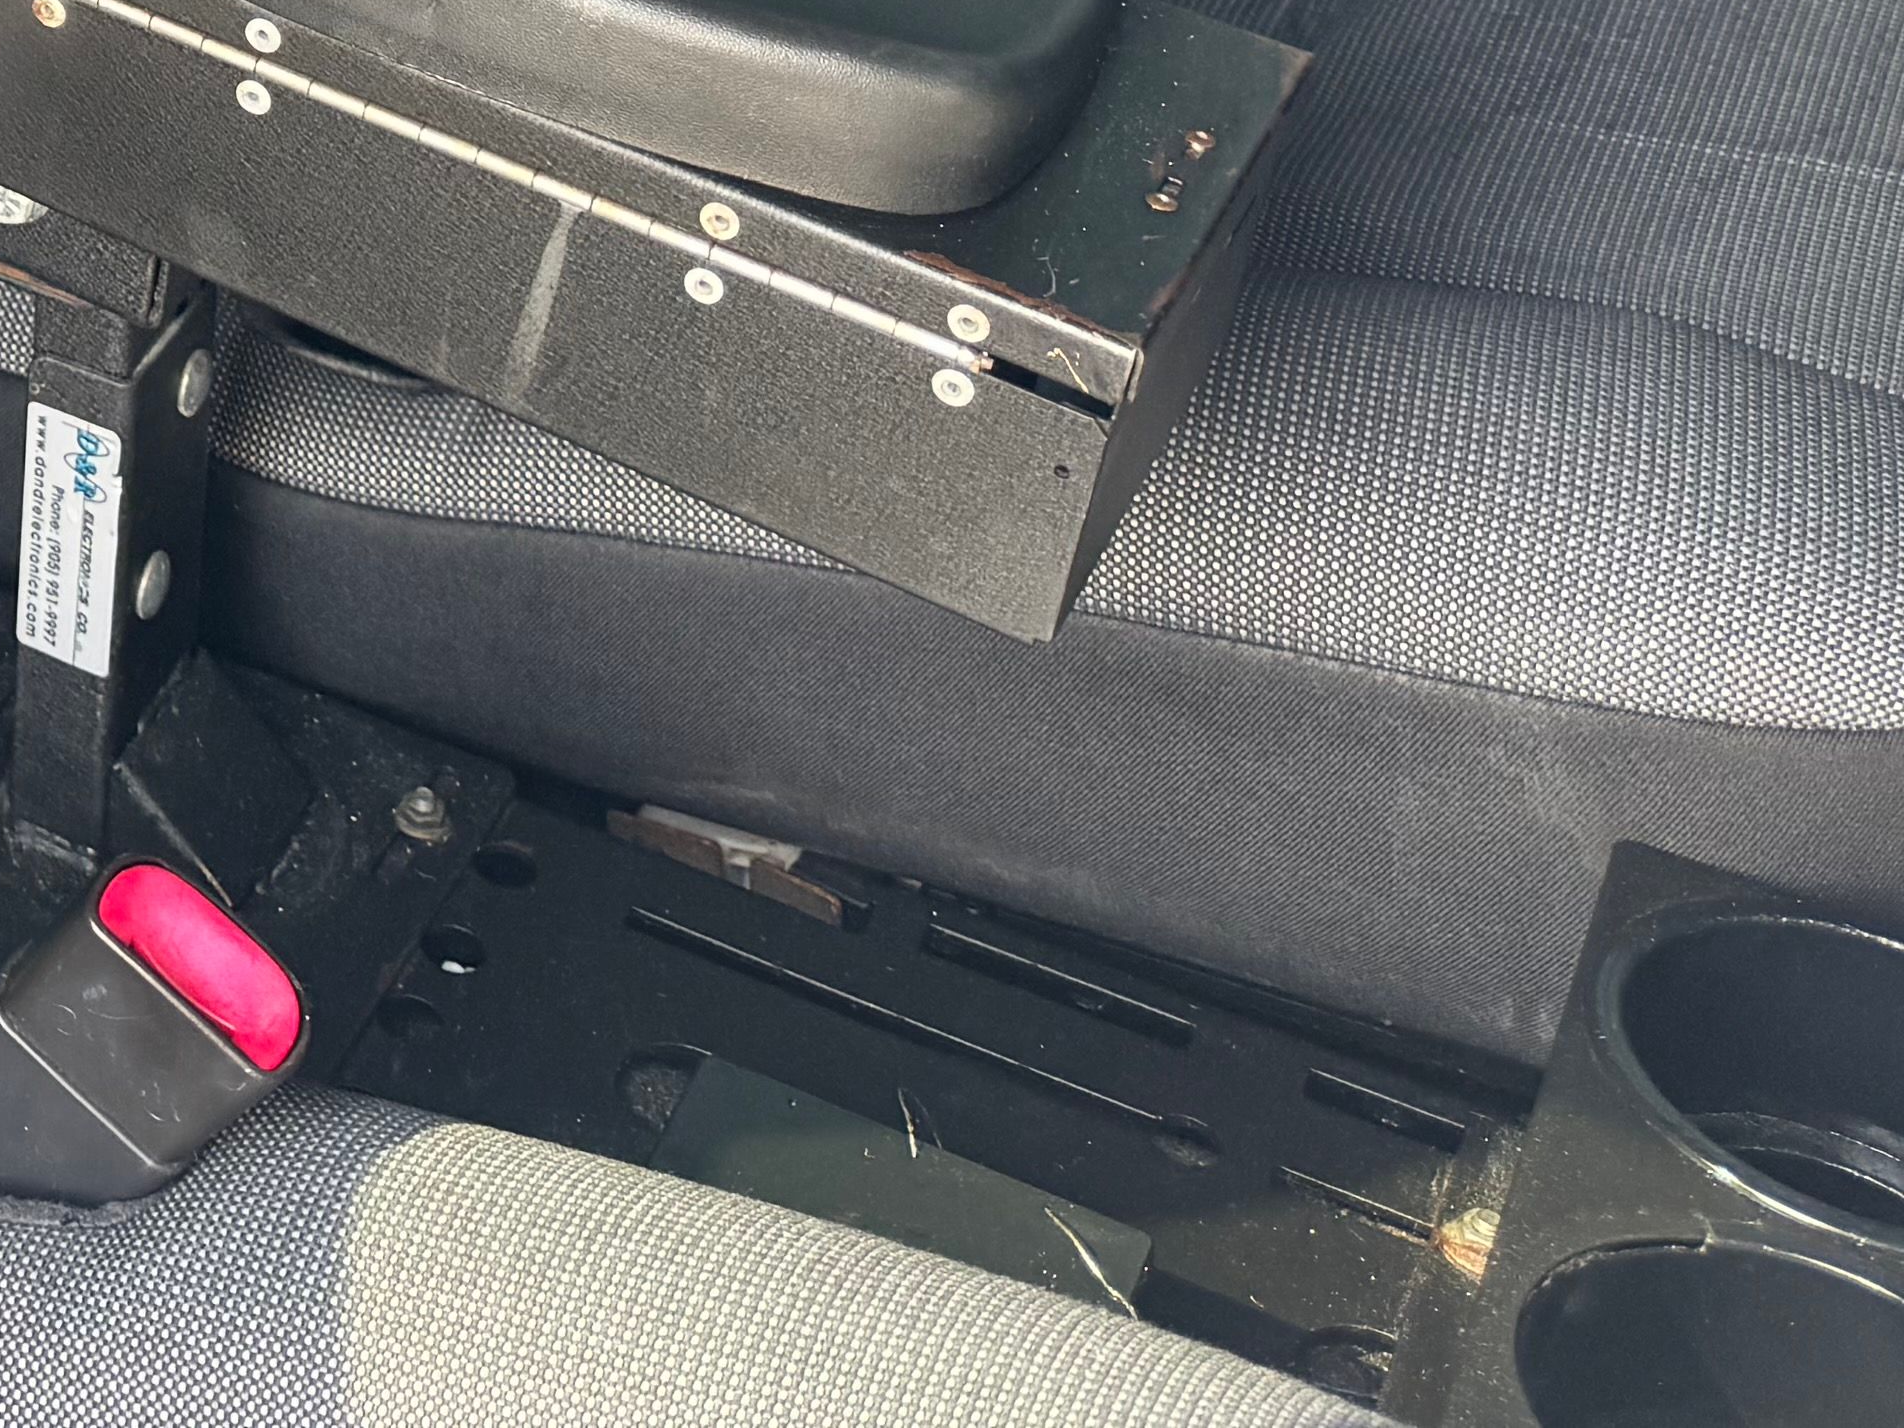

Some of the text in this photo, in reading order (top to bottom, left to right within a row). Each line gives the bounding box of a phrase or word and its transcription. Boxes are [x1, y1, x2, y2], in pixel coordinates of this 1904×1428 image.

[25, 415, 48, 638] www.dandrelectronics.com
[42, 484, 65, 647] Phone: (905) 951-9997
